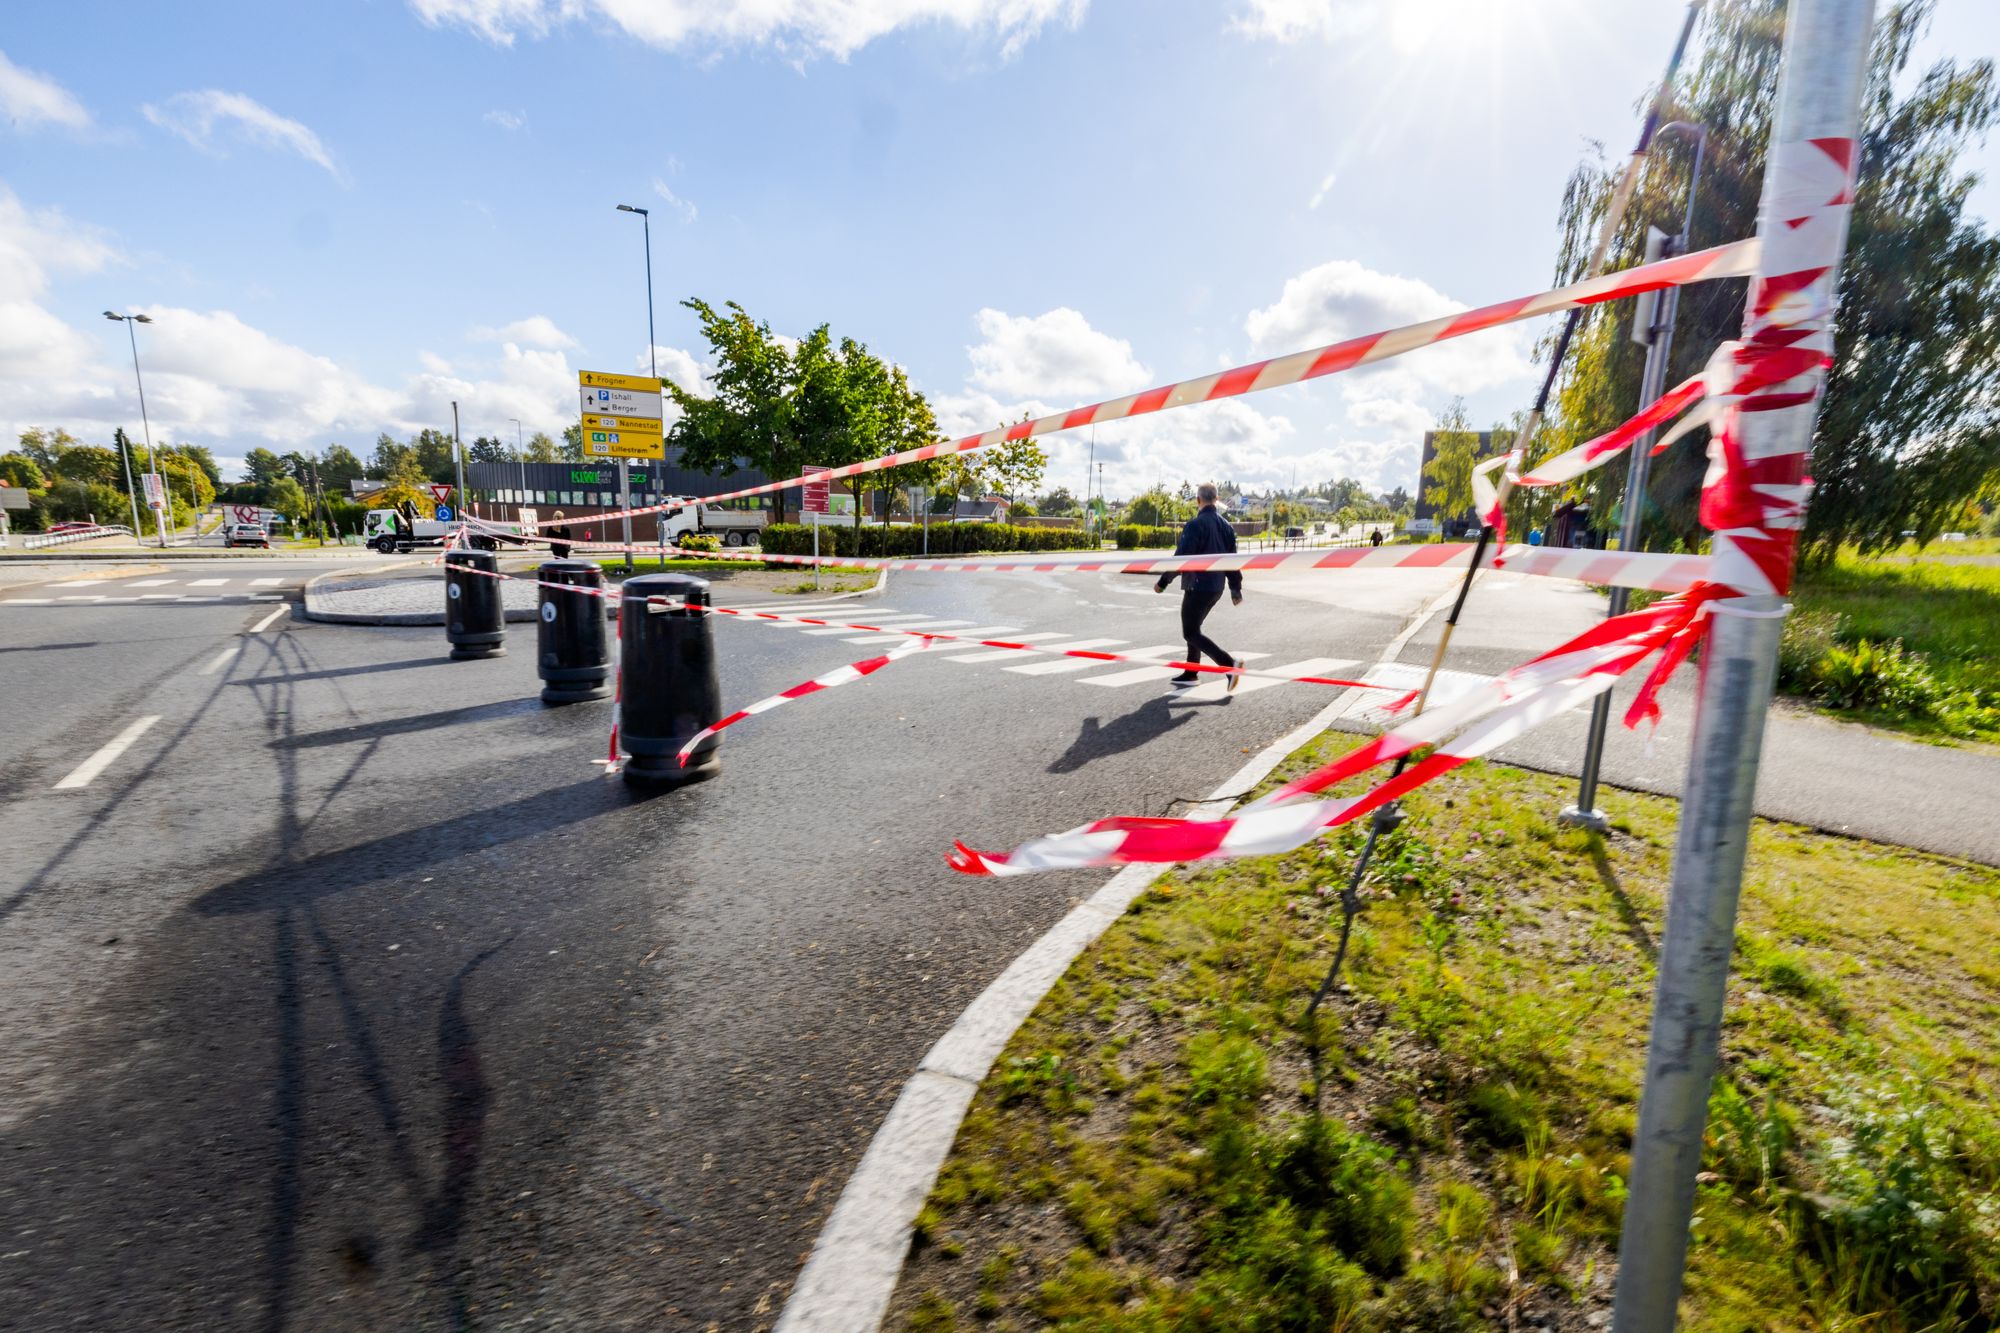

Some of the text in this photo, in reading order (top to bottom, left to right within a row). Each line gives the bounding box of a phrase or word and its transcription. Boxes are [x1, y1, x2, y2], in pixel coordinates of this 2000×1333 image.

[597, 376, 626, 385] Frogner
[612, 404, 637, 413] Berger
[619, 420, 658, 429] Nannestad
[571, 471, 600, 483] KIWI
